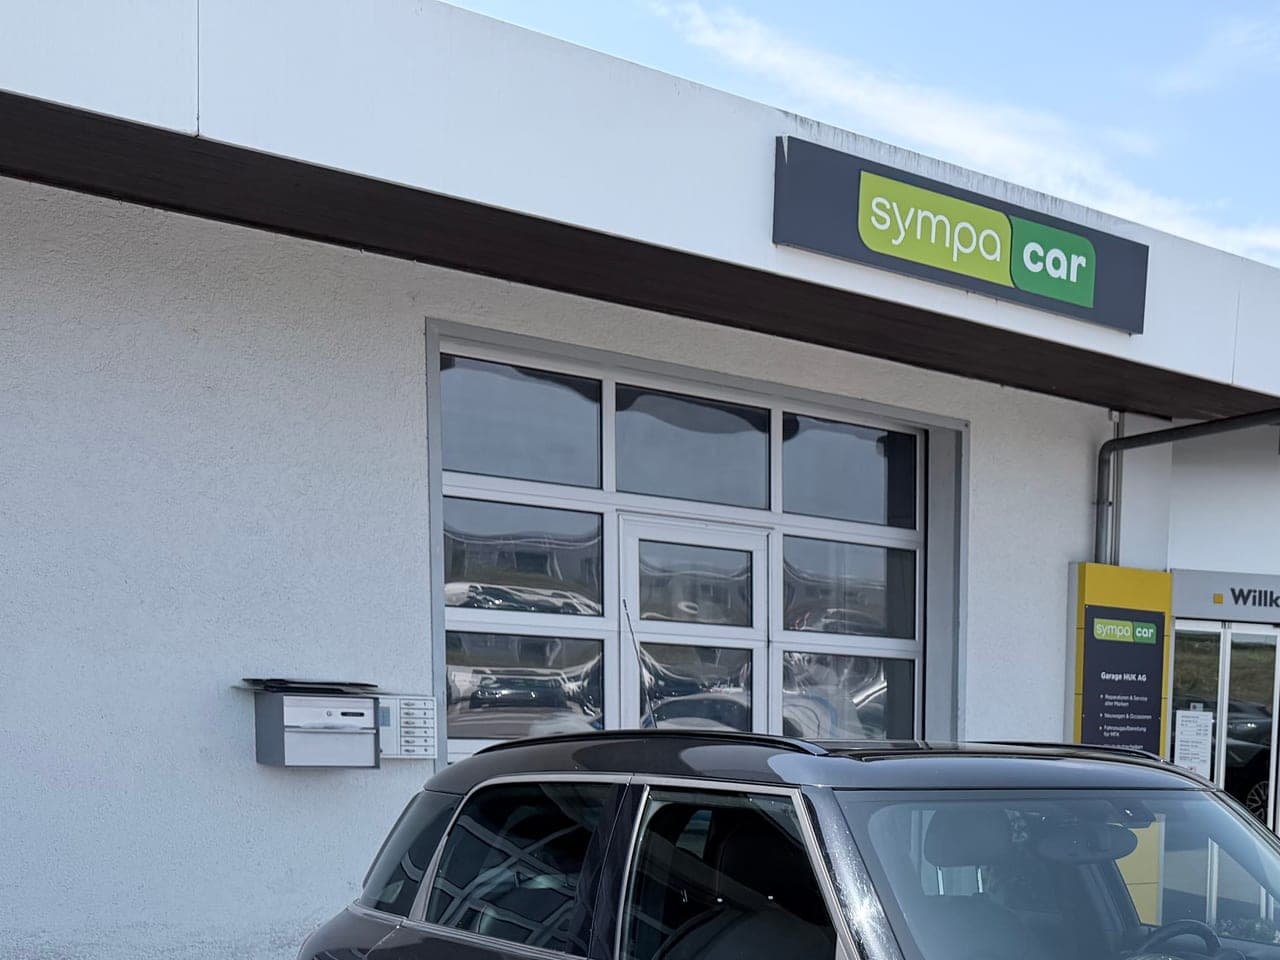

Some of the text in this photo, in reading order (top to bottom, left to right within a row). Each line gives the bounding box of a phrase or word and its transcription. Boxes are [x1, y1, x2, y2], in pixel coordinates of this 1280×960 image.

[870, 196, 1087, 283] sympa car
[1096, 623, 1154, 638] sympa car
[1101, 671, 1147, 682] Garage HUK AG
